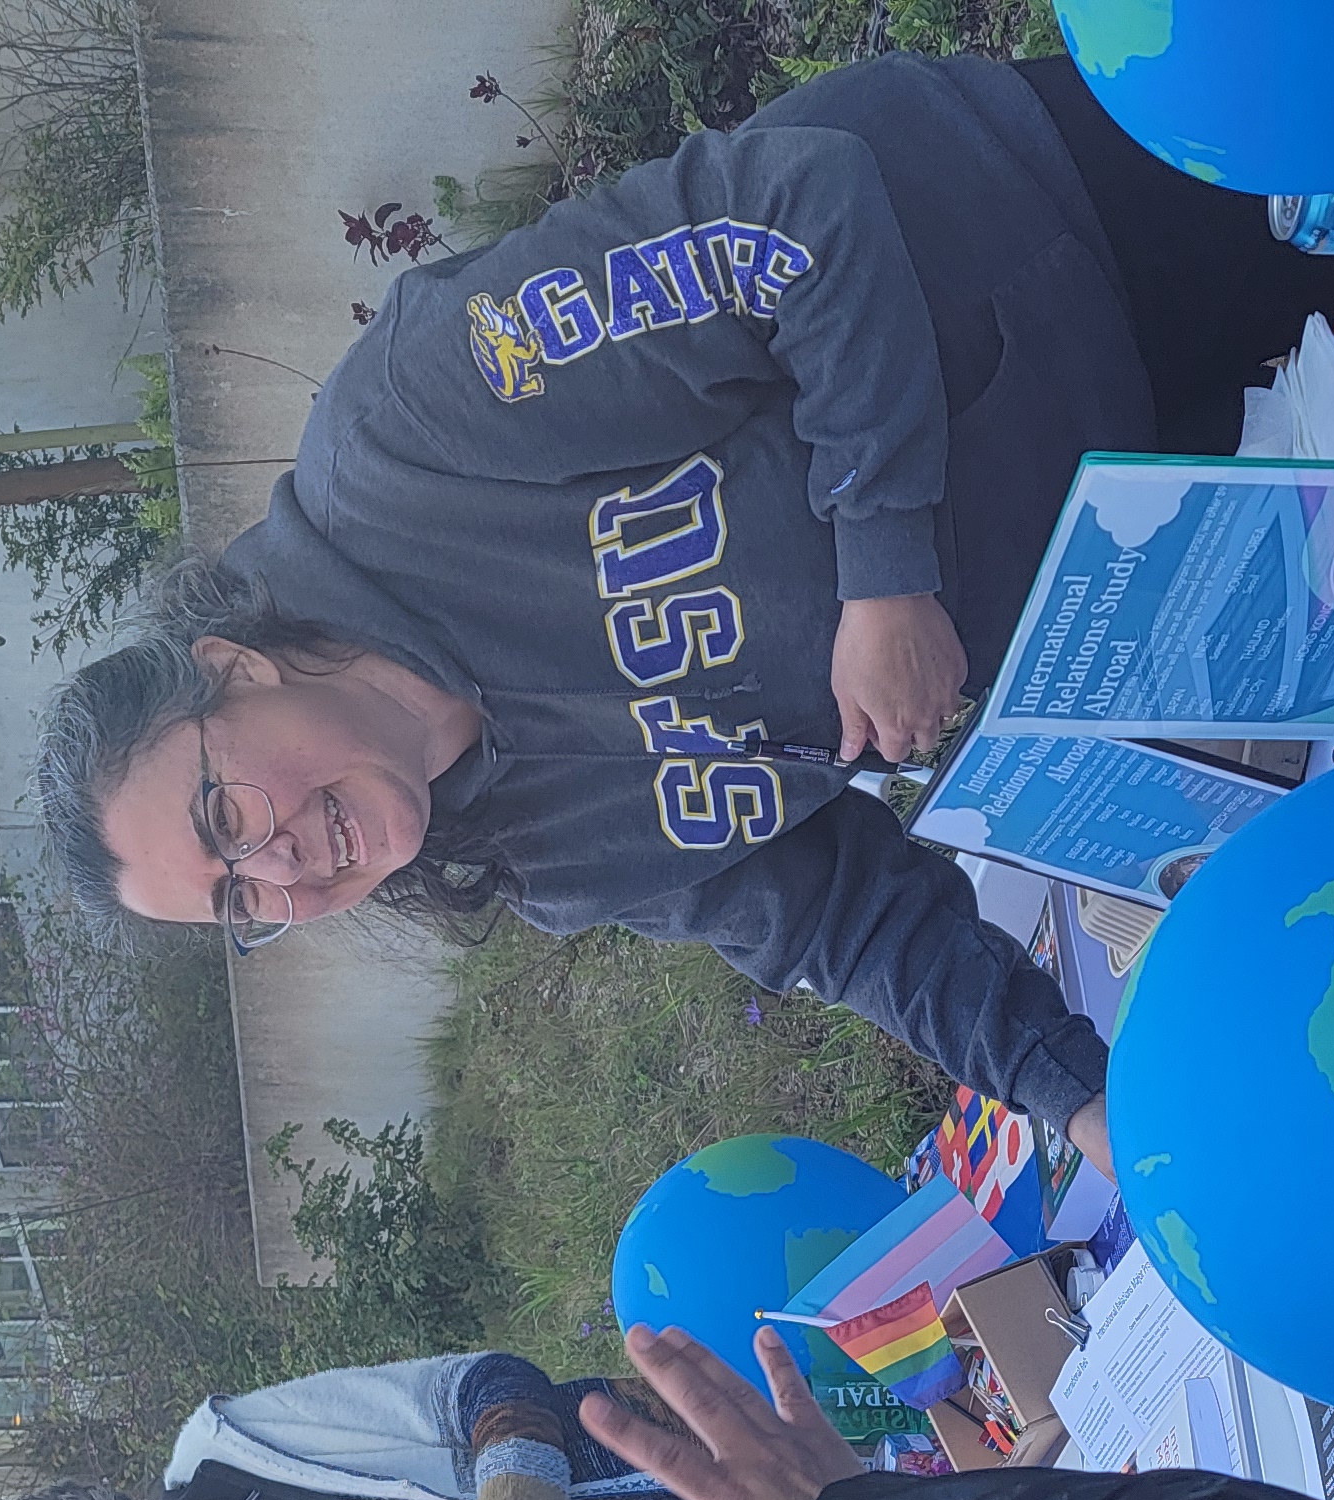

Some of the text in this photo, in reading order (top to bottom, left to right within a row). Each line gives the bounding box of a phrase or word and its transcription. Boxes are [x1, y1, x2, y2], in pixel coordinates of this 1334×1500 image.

[1166, 566, 1195, 597] Program
[1175, 581, 1200, 611] covered
[1189, 557, 1212, 580] under
[1222, 527, 1269, 595] SOUTH KOREA
[1240, 575, 1262, 594] Seoul
[588, 452, 785, 850] SFSU
[1008, 575, 1095, 715] International
[1043, 547, 1151, 715] Relations Study
[1190, 634, 1214, 659] INDIA
[1238, 619, 1273, 661] THAILAND
[1292, 633, 1319, 661] HONG
[1307, 644, 1329, 662] Hong
[1077, 641, 1140, 717] Abroad
[1162, 689, 1187, 715] JAPAN
[980, 729, 1060, 818] Relations Stud
[1041, 734, 1097, 785] Abroad
